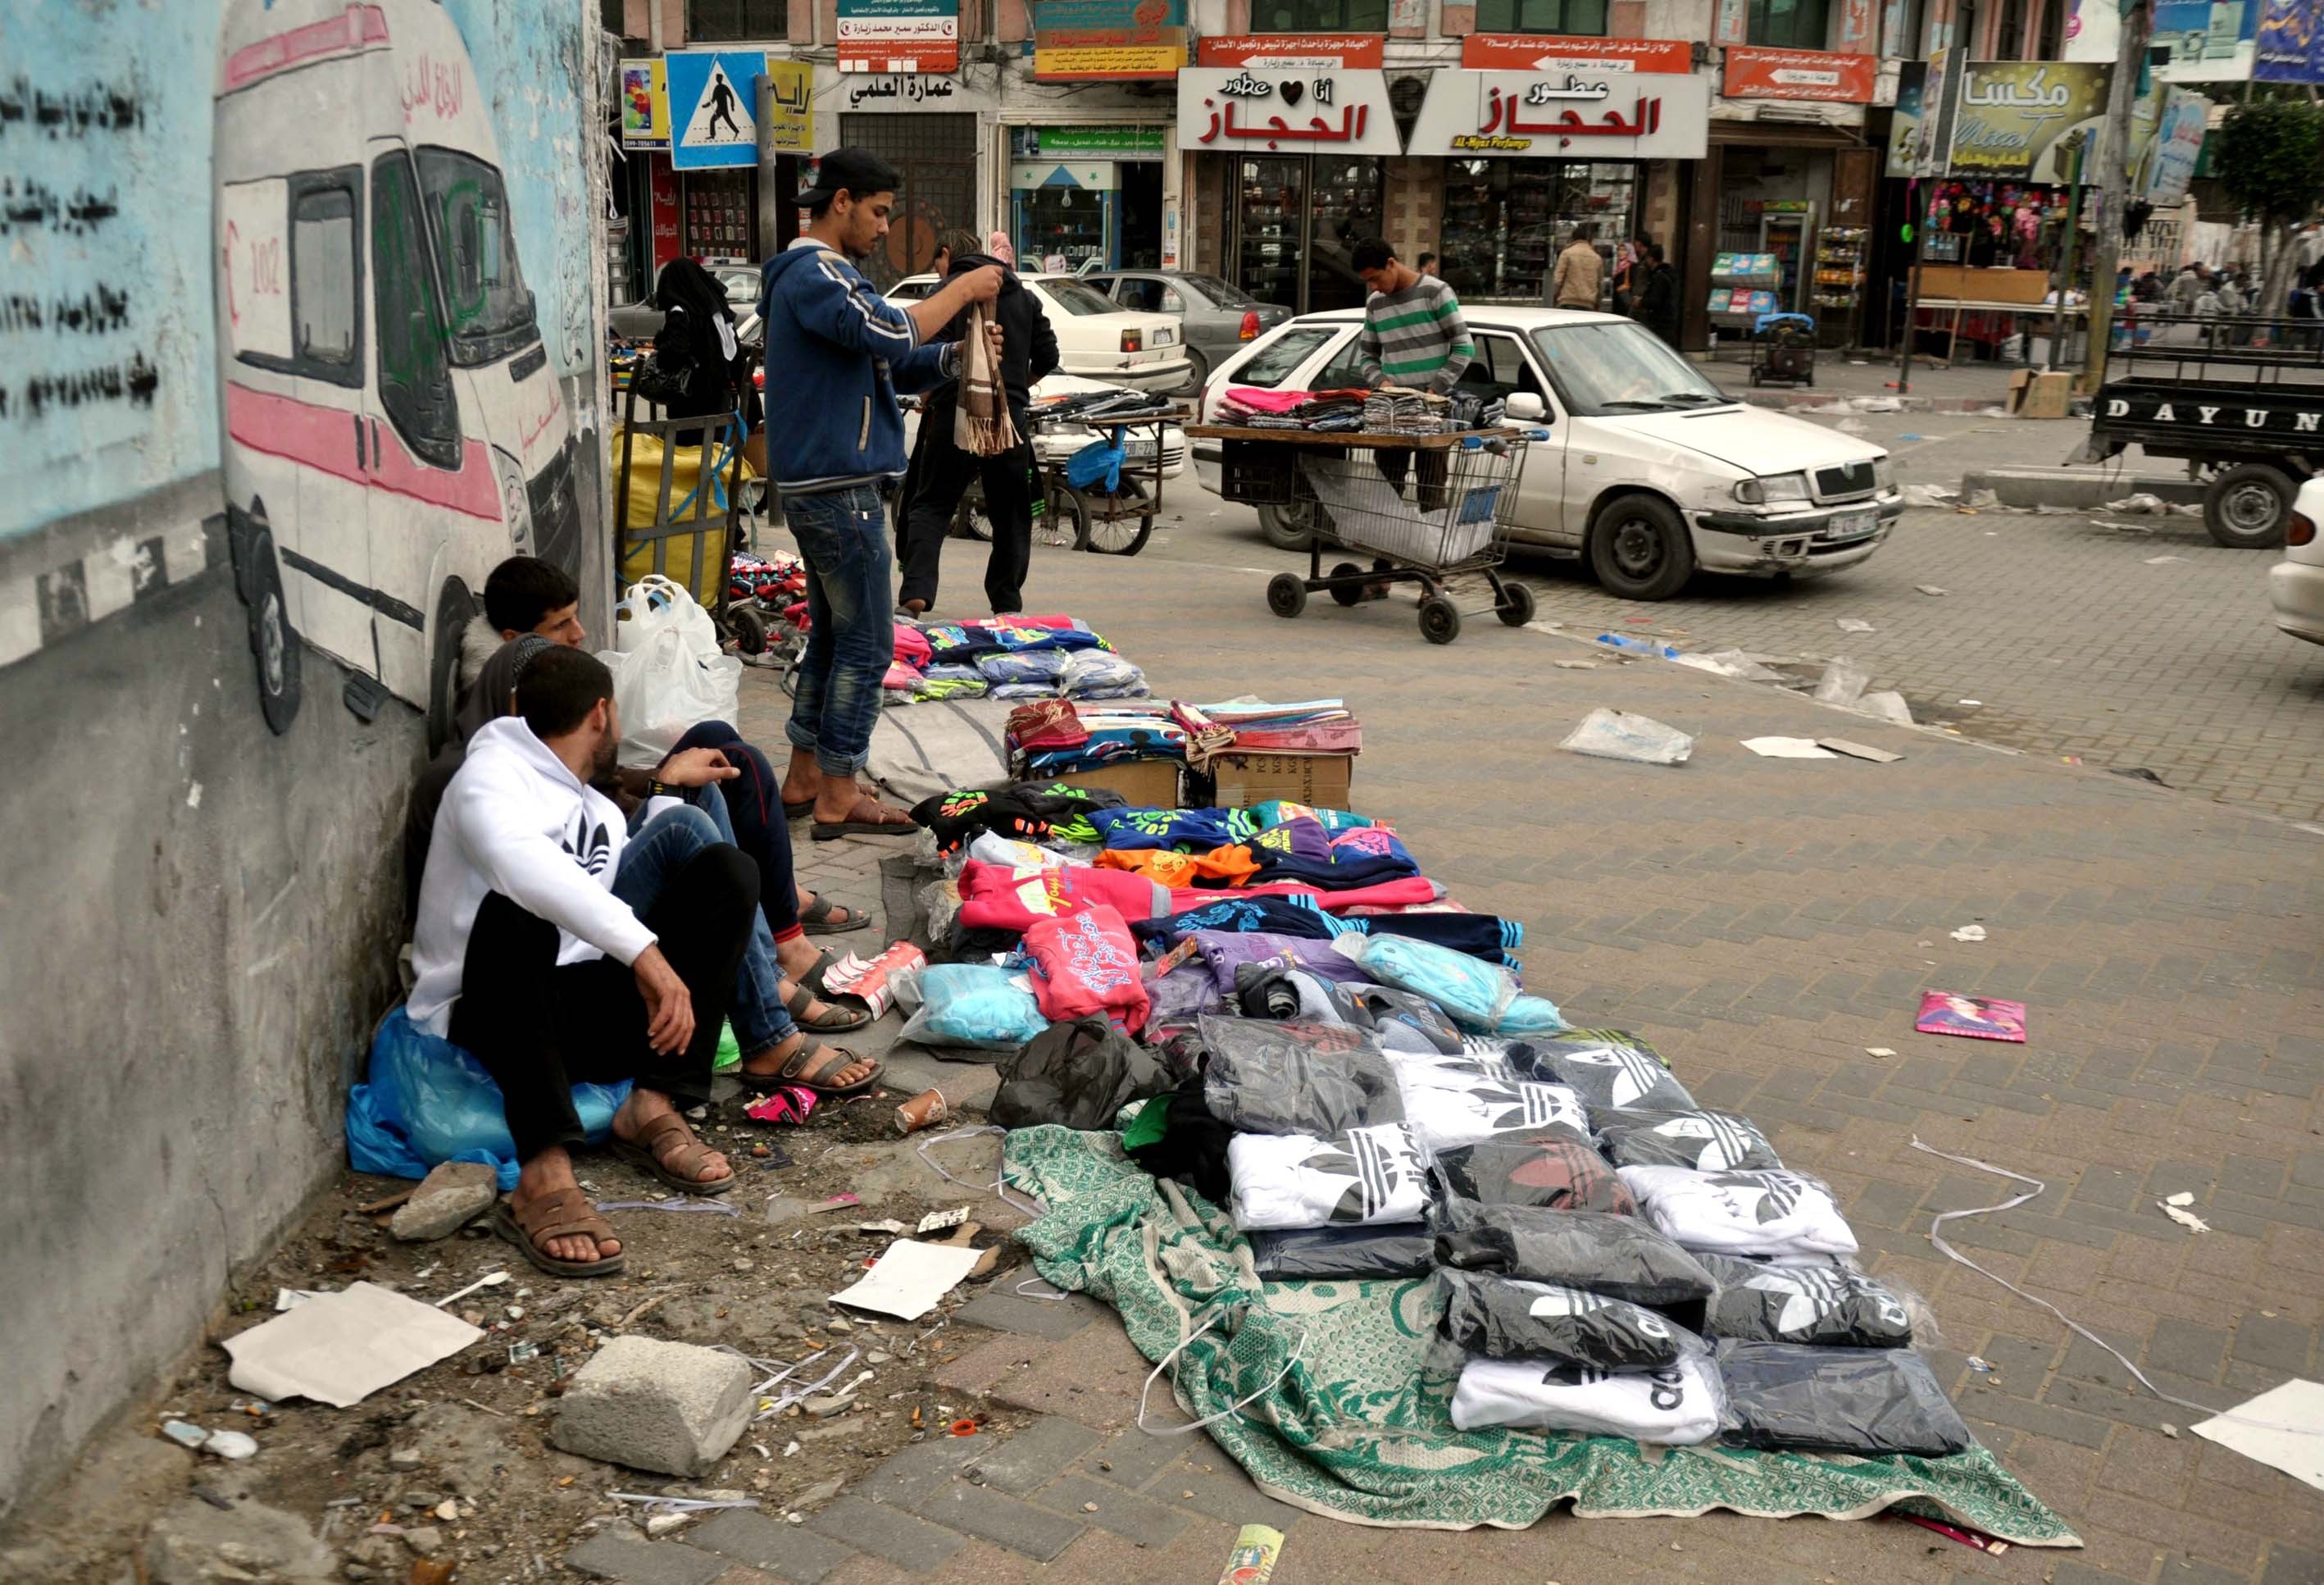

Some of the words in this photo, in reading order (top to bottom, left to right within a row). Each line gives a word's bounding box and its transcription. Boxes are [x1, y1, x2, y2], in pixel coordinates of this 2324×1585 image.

[872, 24, 892, 33] محمد
[894, 25, 912, 35] سمير
[914, 22, 940, 34] الدكتور
[850, 75, 904, 109] العلمي
[907, 75, 953, 102] عمارة
[1218, 72, 1272, 97] عطور
[1526, 75, 1609, 104] عطور
[1963, 66, 2070, 107] مكسا
[1198, 98, 1369, 150] الحجاز
[1480, 86, 1662, 148] الحجاز
[251, 236, 281, 295] 102
[2107, 399, 2322, 431] DAYUN
[1257, 755, 1267, 774] PCS
[1272, 754, 1282, 774] KGS
